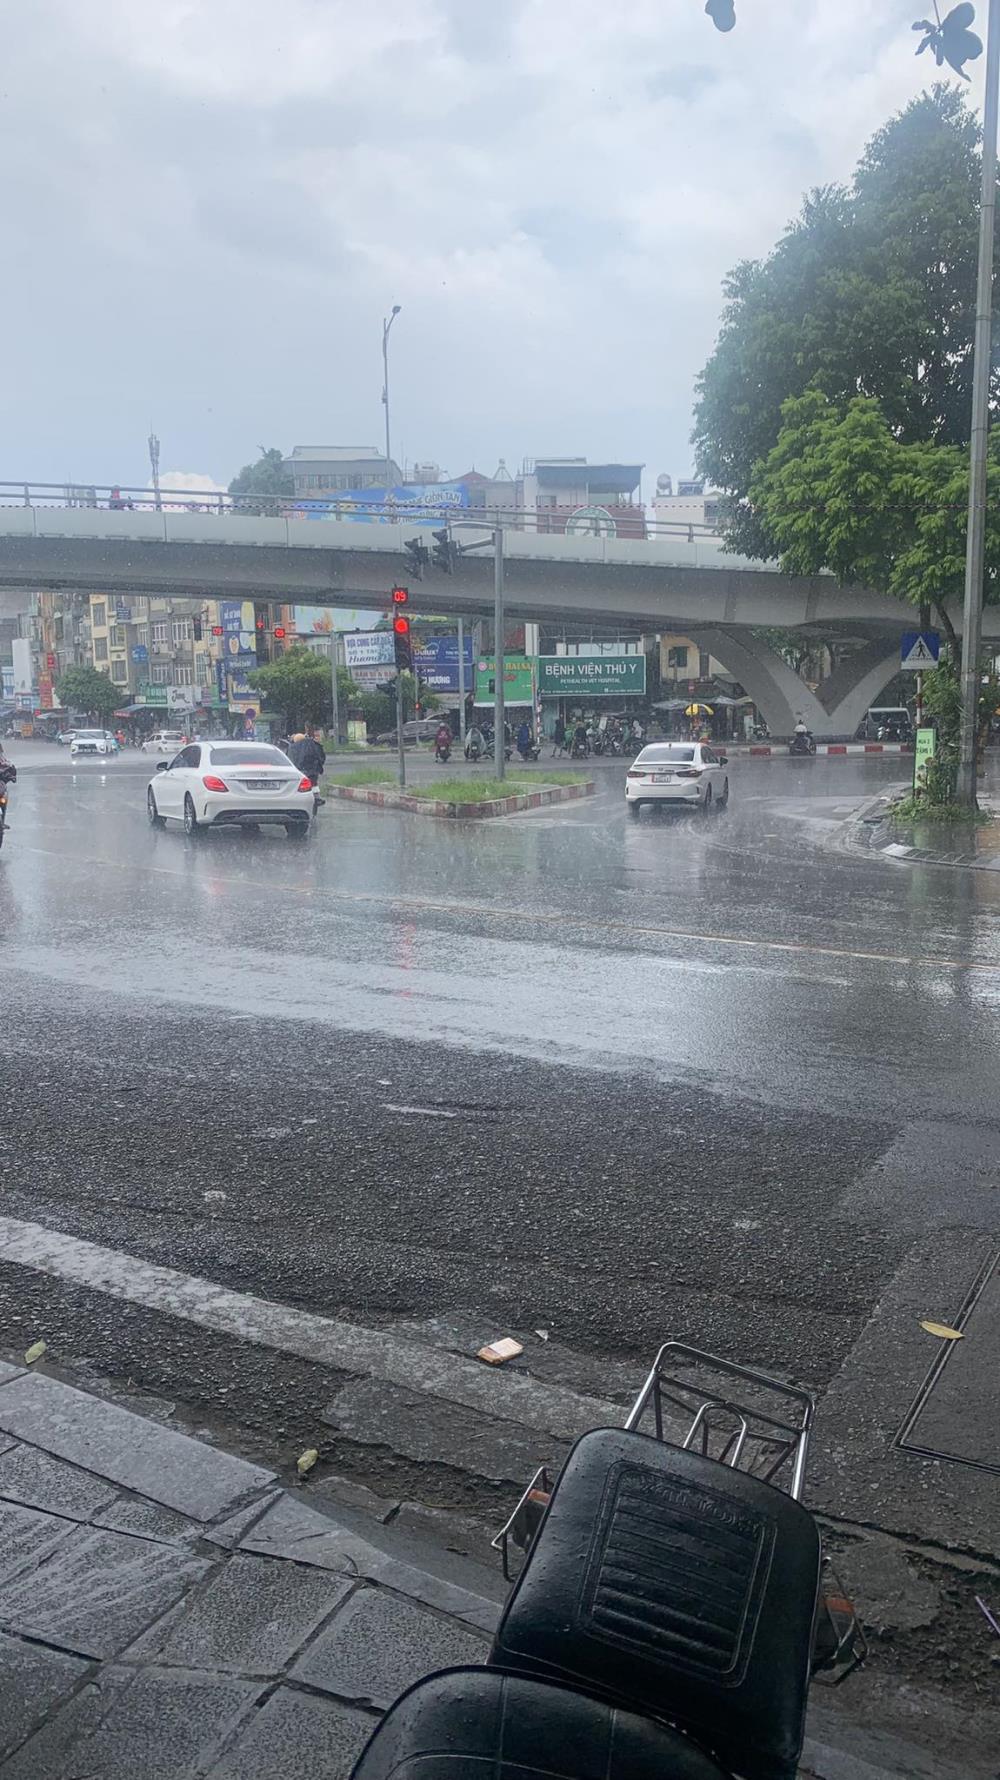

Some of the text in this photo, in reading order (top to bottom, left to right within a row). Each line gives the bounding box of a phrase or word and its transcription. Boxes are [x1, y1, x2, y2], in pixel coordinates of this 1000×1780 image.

[394, 591, 407, 602] 09
[545, 660, 637, 678] BỆNH VIỆN THỦ Y
